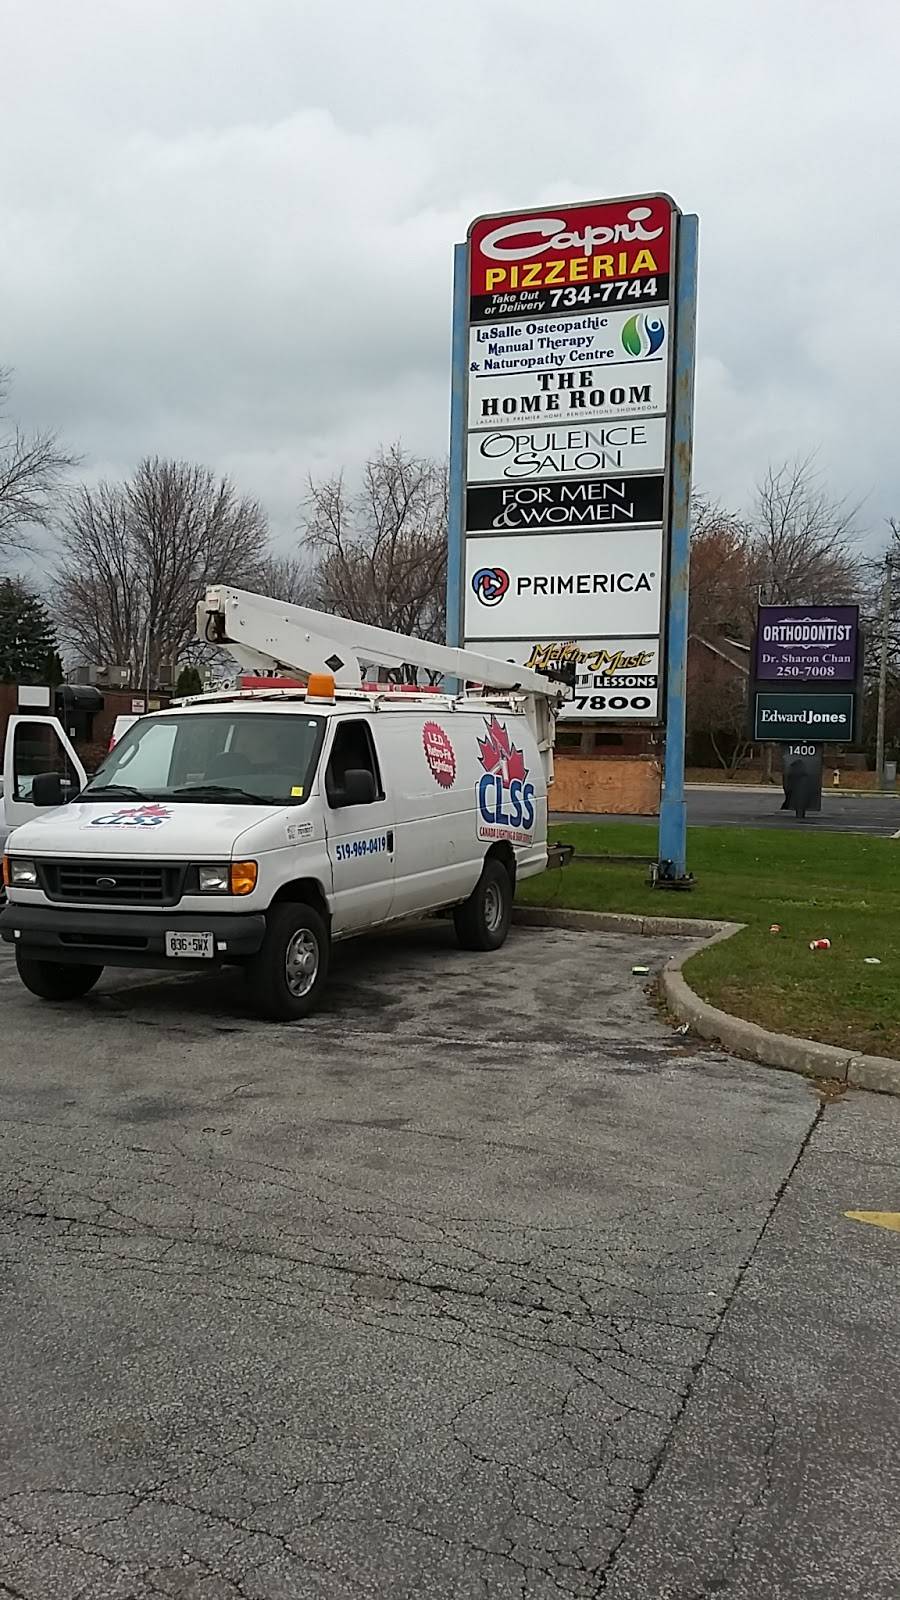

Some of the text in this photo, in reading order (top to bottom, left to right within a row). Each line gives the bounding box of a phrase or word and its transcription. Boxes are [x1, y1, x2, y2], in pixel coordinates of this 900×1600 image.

[480, 207, 664, 261] Capri
[486, 250, 657, 291] PIZZERIA
[492, 292, 539, 304] Take Out
[550, 278, 657, 307] 734-7744
[484, 300, 545, 314] or Delivery
[477, 317, 608, 342] LaSalle Osteopathic
[488, 336, 594, 356] Manual Therapy
[470, 350, 614, 372] & Naturopathy Centre
[537, 370, 593, 391] THE
[482, 385, 651, 416] HOME ROOM
[480, 426, 648, 458] OPULENCE
[504, 450, 624, 477] SALON
[502, 482, 626, 505] FOR MEN
[764, 626, 852, 641] ORTHODONTIST
[588, 650, 656, 676] Music
[762, 654, 850, 662] Dr. Sharon Chan
[596, 676, 656, 687] LESSONS
[777, 666, 835, 676] 250-7008
[789, 746, 816, 756] 1400
[478, 774, 534, 830] CLSS
[91, 816, 171, 826] CLSS
[336, 836, 386, 860] 519-969-0419
